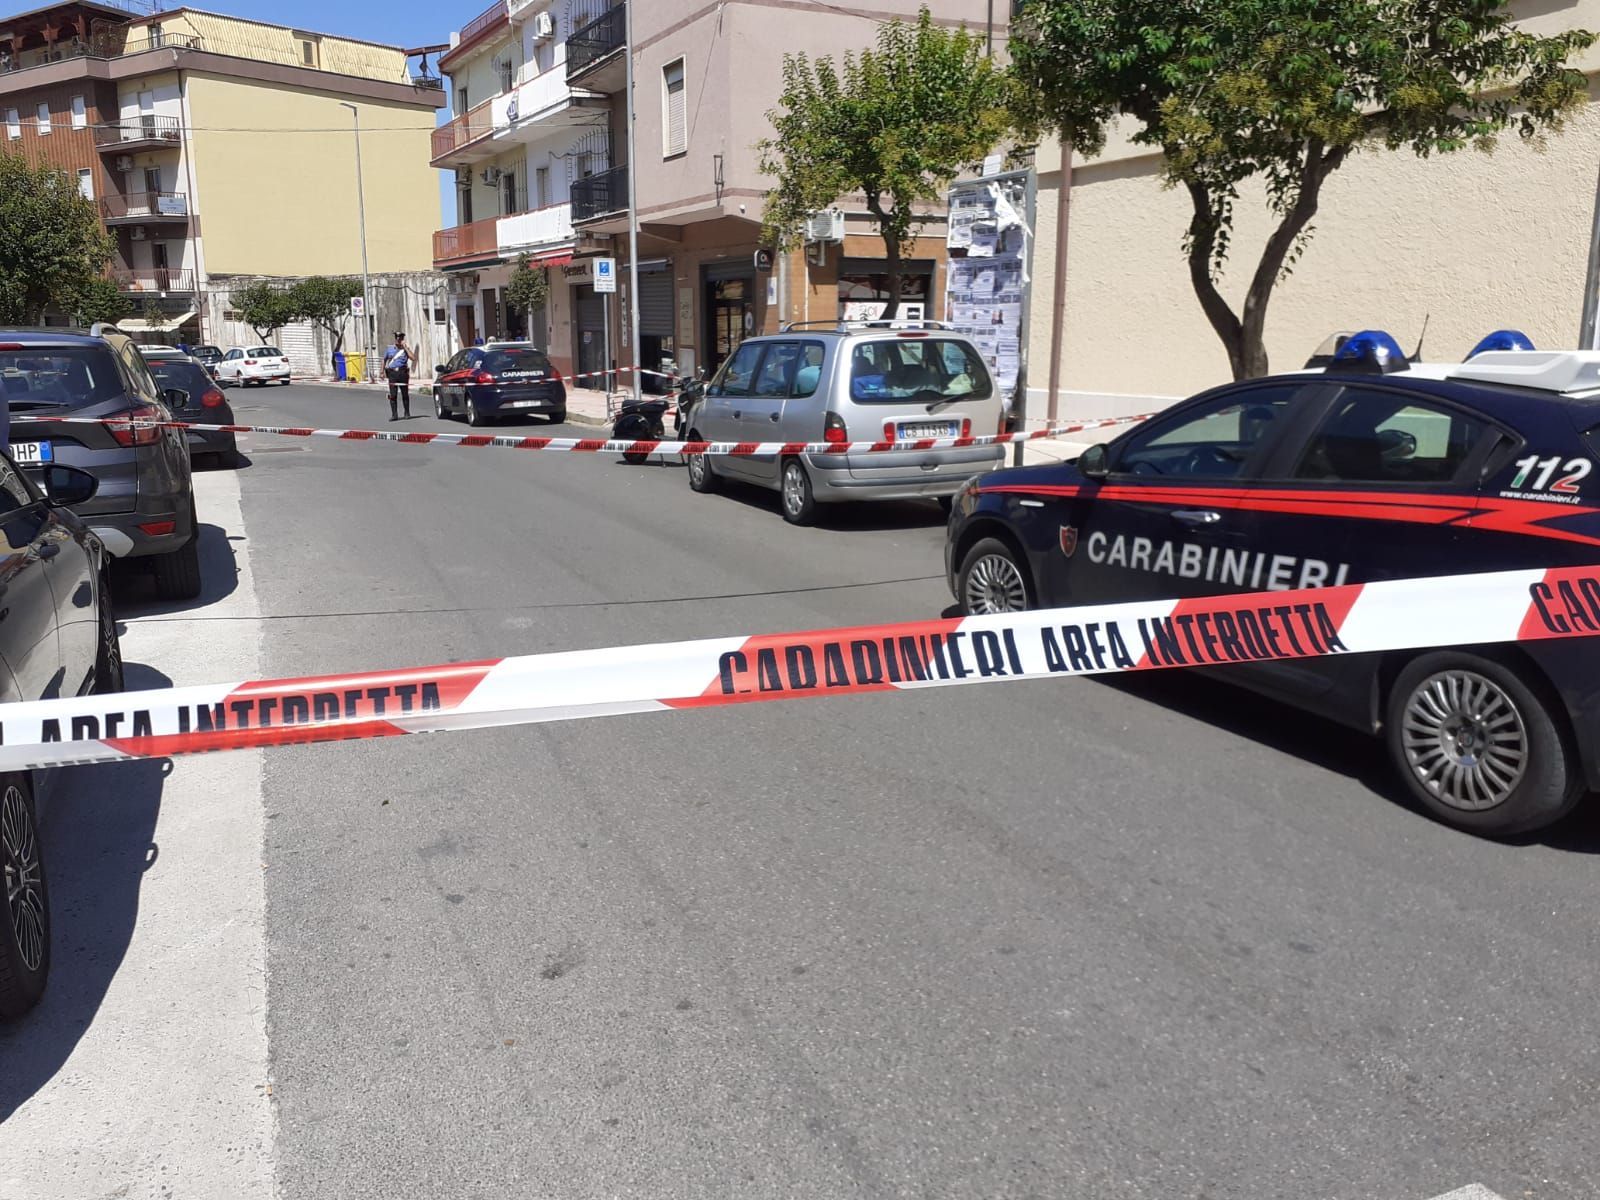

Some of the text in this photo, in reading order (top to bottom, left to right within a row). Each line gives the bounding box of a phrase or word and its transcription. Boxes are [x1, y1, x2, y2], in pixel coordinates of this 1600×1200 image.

[1511, 455, 1592, 493] 112
[1500, 491, 1581, 504] www.carabinieri.it
[1088, 531, 1350, 591] CARABINIERI
